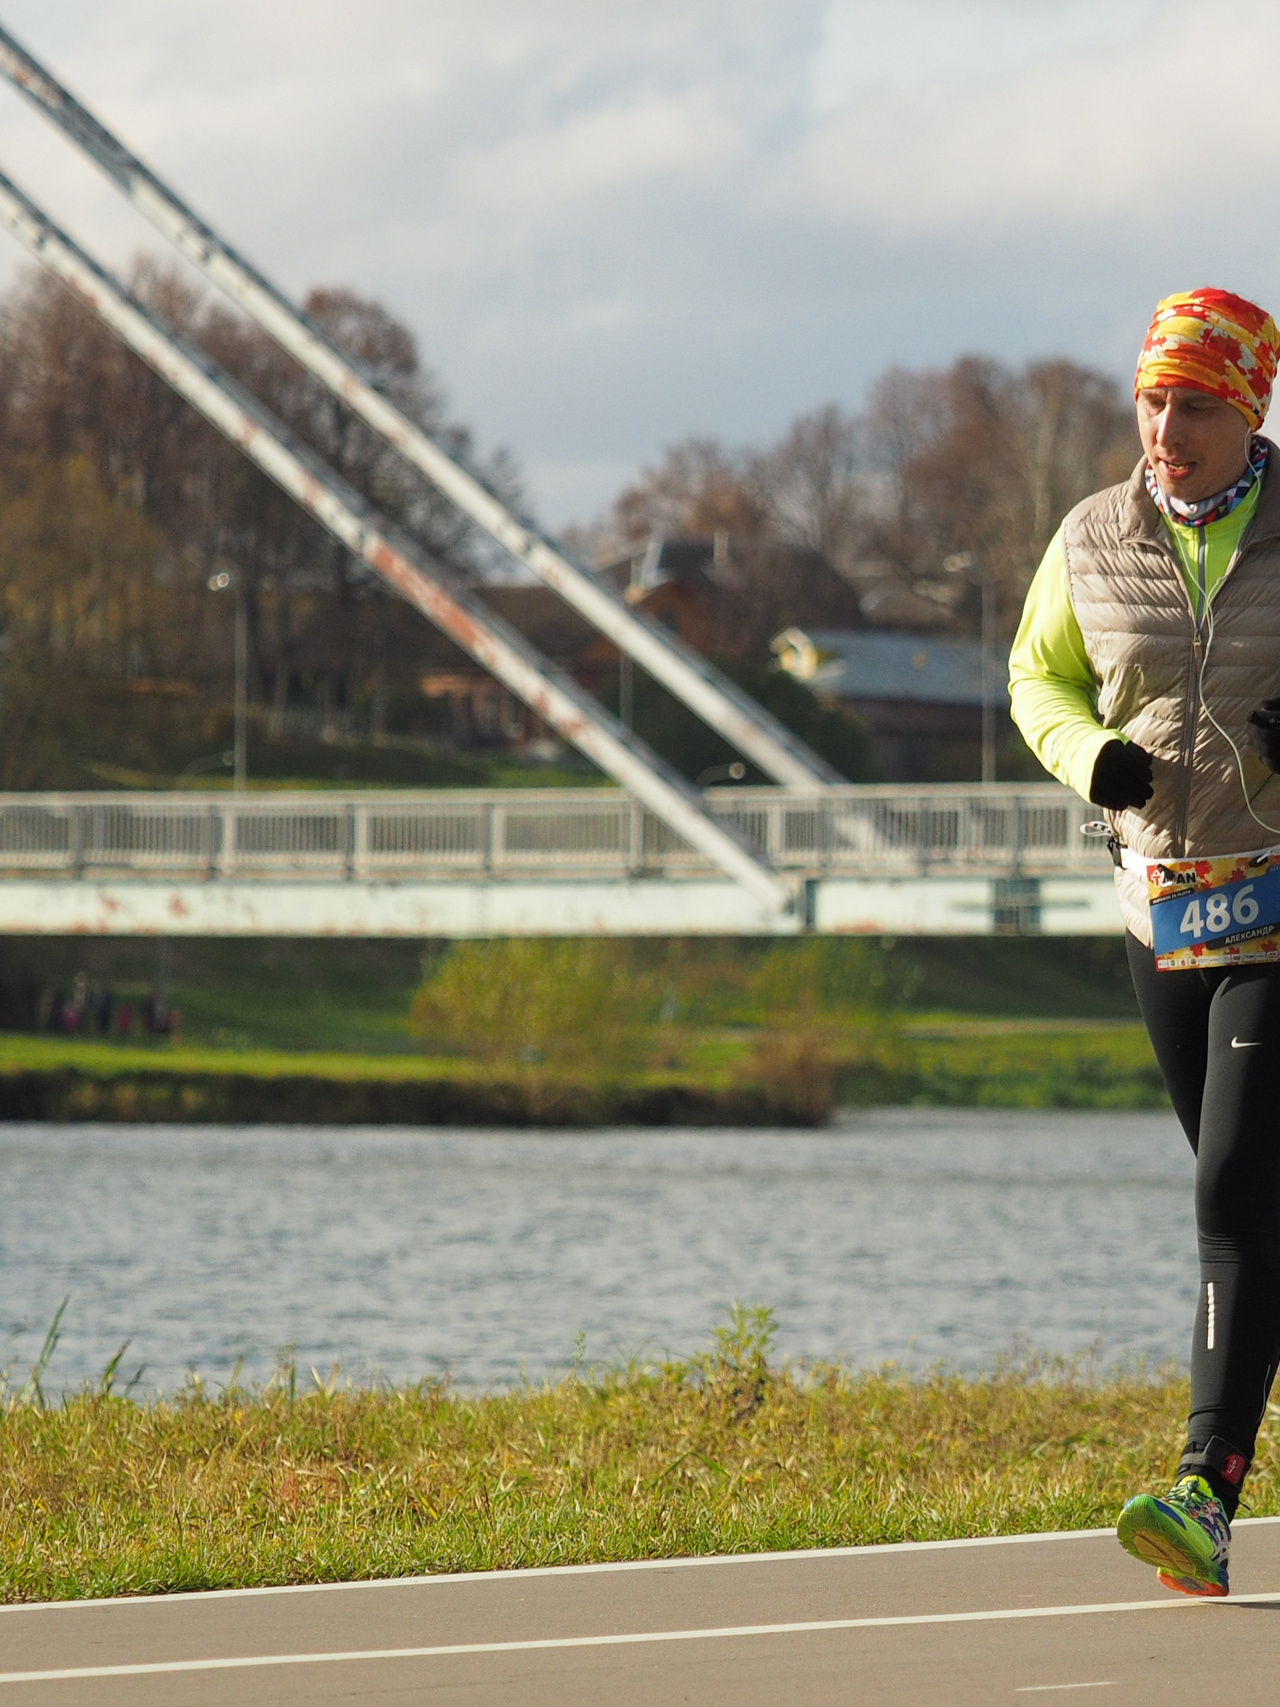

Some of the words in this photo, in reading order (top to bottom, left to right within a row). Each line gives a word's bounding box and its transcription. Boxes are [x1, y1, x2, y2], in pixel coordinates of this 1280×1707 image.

[1152, 870, 1197, 887] TAN
[1179, 884, 1260, 938] 486
[1225, 925, 1275, 945] АЛЕКСАНДР
